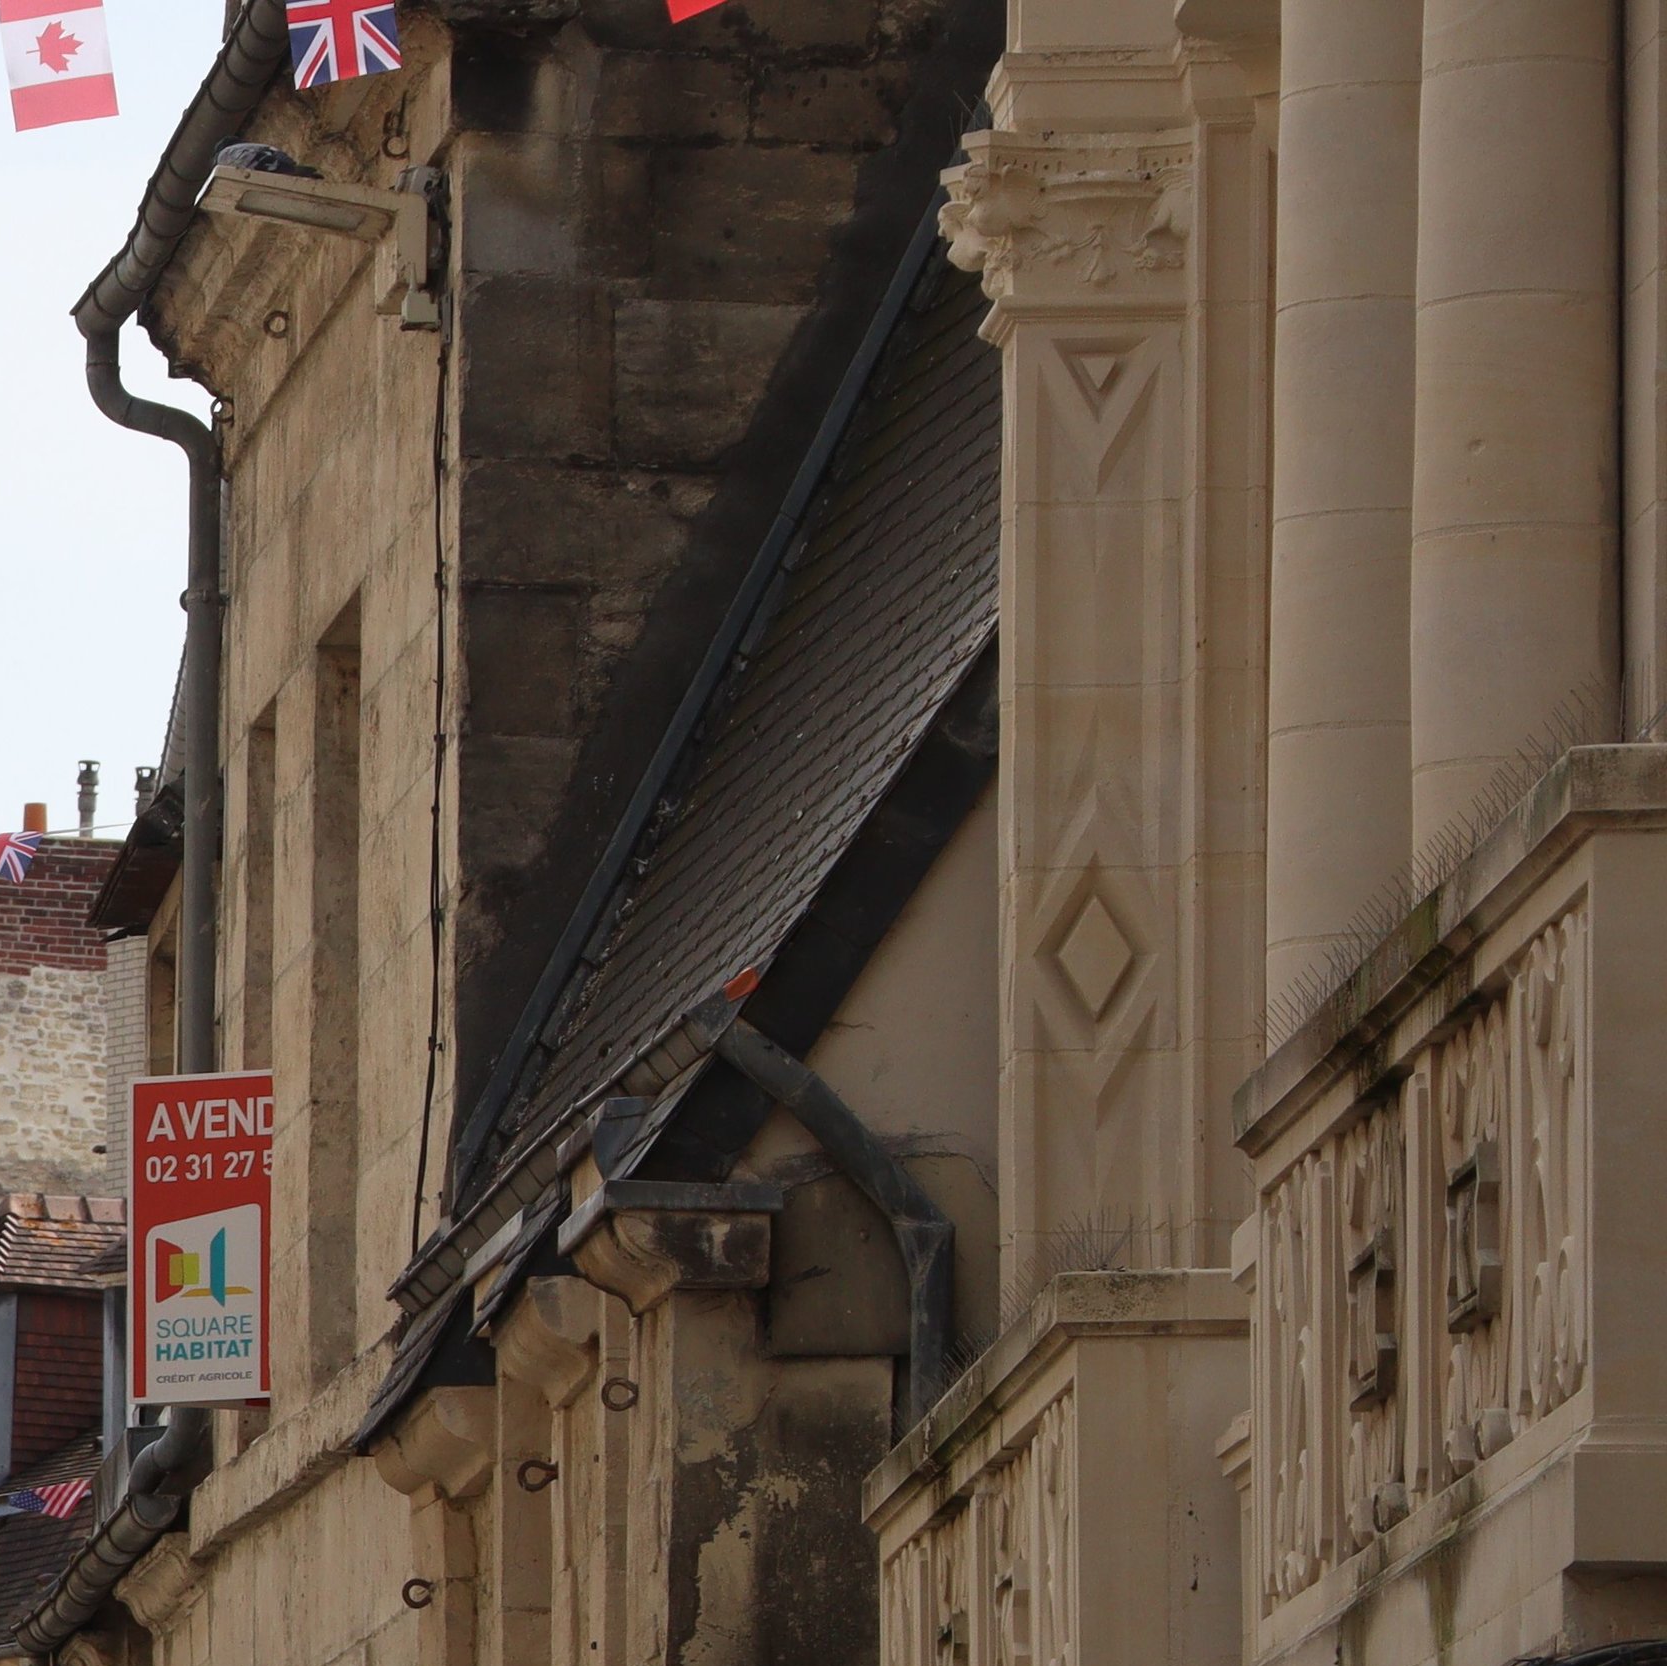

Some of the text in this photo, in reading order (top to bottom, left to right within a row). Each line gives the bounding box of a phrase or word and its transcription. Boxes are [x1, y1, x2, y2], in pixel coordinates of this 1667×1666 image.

[146, 1102, 177, 1143] A
[145, 1155, 178, 1183] 02
[185, 1153, 213, 1180] 31
[223, 1151, 255, 1179] 27
[155, 1314, 253, 1340] SQUARE
[155, 1338, 253, 1362] HABITAT
[156, 1370, 253, 1384] CRÉDIT AGRICOLE
